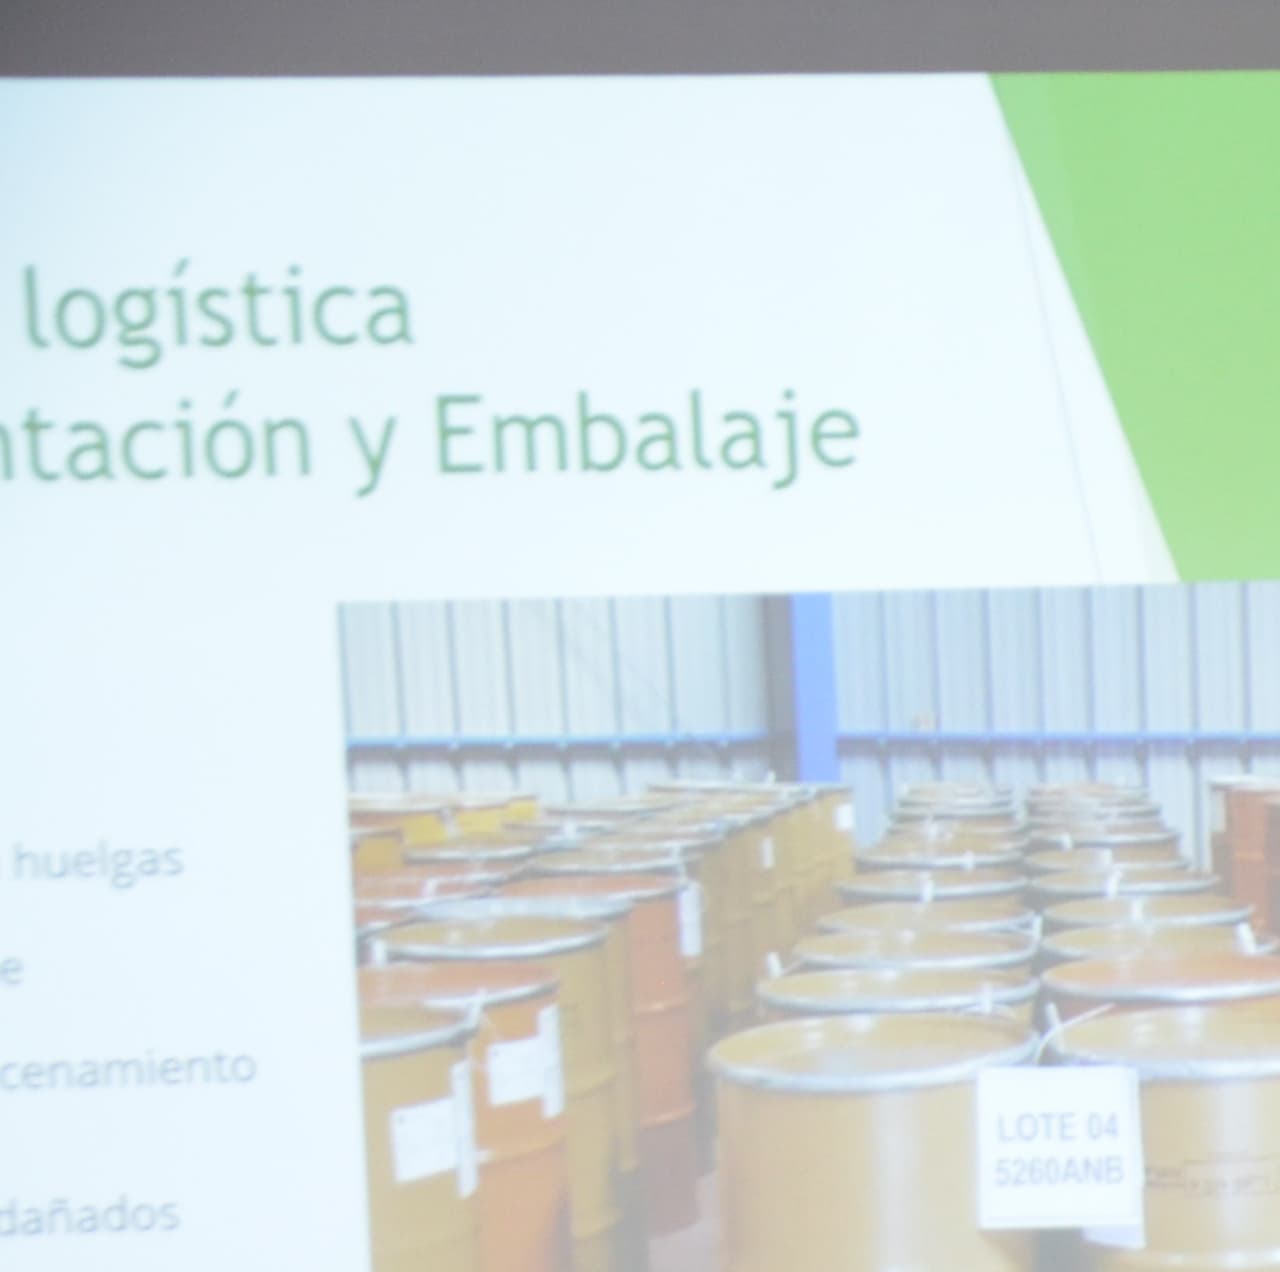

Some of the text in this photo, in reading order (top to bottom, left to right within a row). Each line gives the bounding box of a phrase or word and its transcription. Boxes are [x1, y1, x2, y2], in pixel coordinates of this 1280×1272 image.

[21, 257, 415, 370] logística
[0, 388, 862, 498] tación y Embalaje
[11, 840, 186, 891] huelgas
[996, 1111, 1120, 1142] LOTE 04
